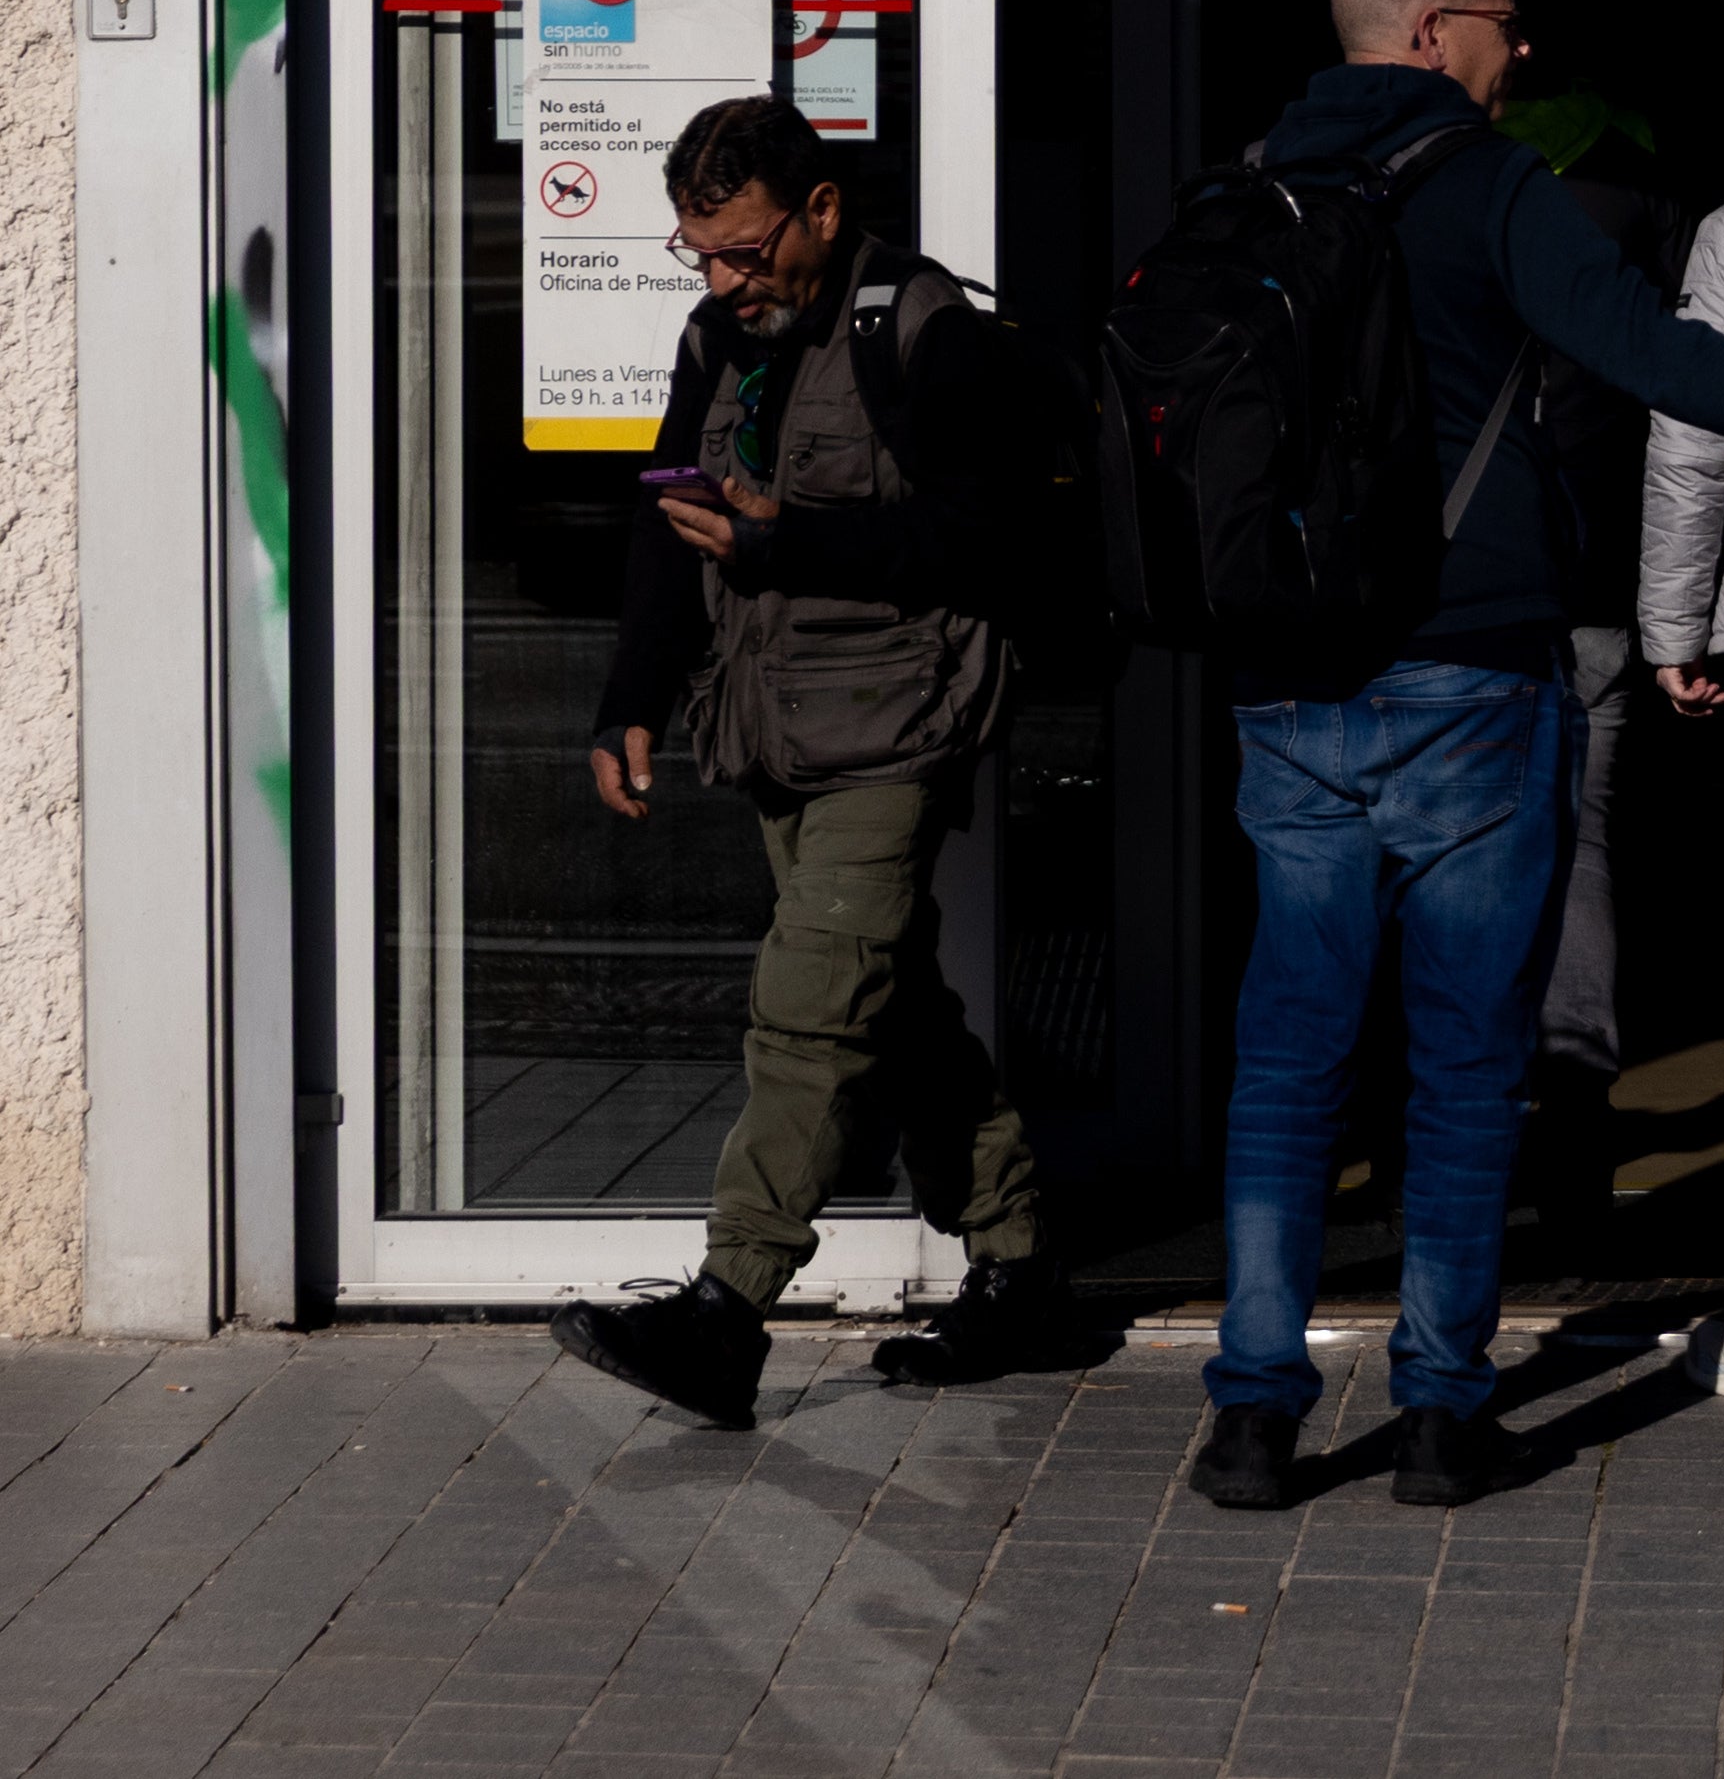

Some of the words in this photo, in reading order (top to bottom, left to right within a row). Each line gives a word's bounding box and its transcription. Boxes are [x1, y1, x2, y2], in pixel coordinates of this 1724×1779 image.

[544, 22, 609, 42] espacio
[544, 41, 568, 57] sin
[573, 43, 622, 57] humo
[540, 100, 563, 113] No
[569, 100, 604, 113] está
[540, 119, 621, 135] permitido
[627, 119, 641, 132] el
[540, 141, 601, 151] acceso
[607, 141, 637, 151] con
[541, 251, 618, 267] Horario
[540, 274, 603, 291] Oficina
[608, 275, 631, 291] de
[540, 366, 596, 382] Lunes
[603, 369, 614, 382] a
[540, 389, 566, 405] De
[572, 389, 583, 405] 9
[590, 389, 605, 405] h.
[612, 393, 624, 405] a
[631, 389, 652, 404] 14
